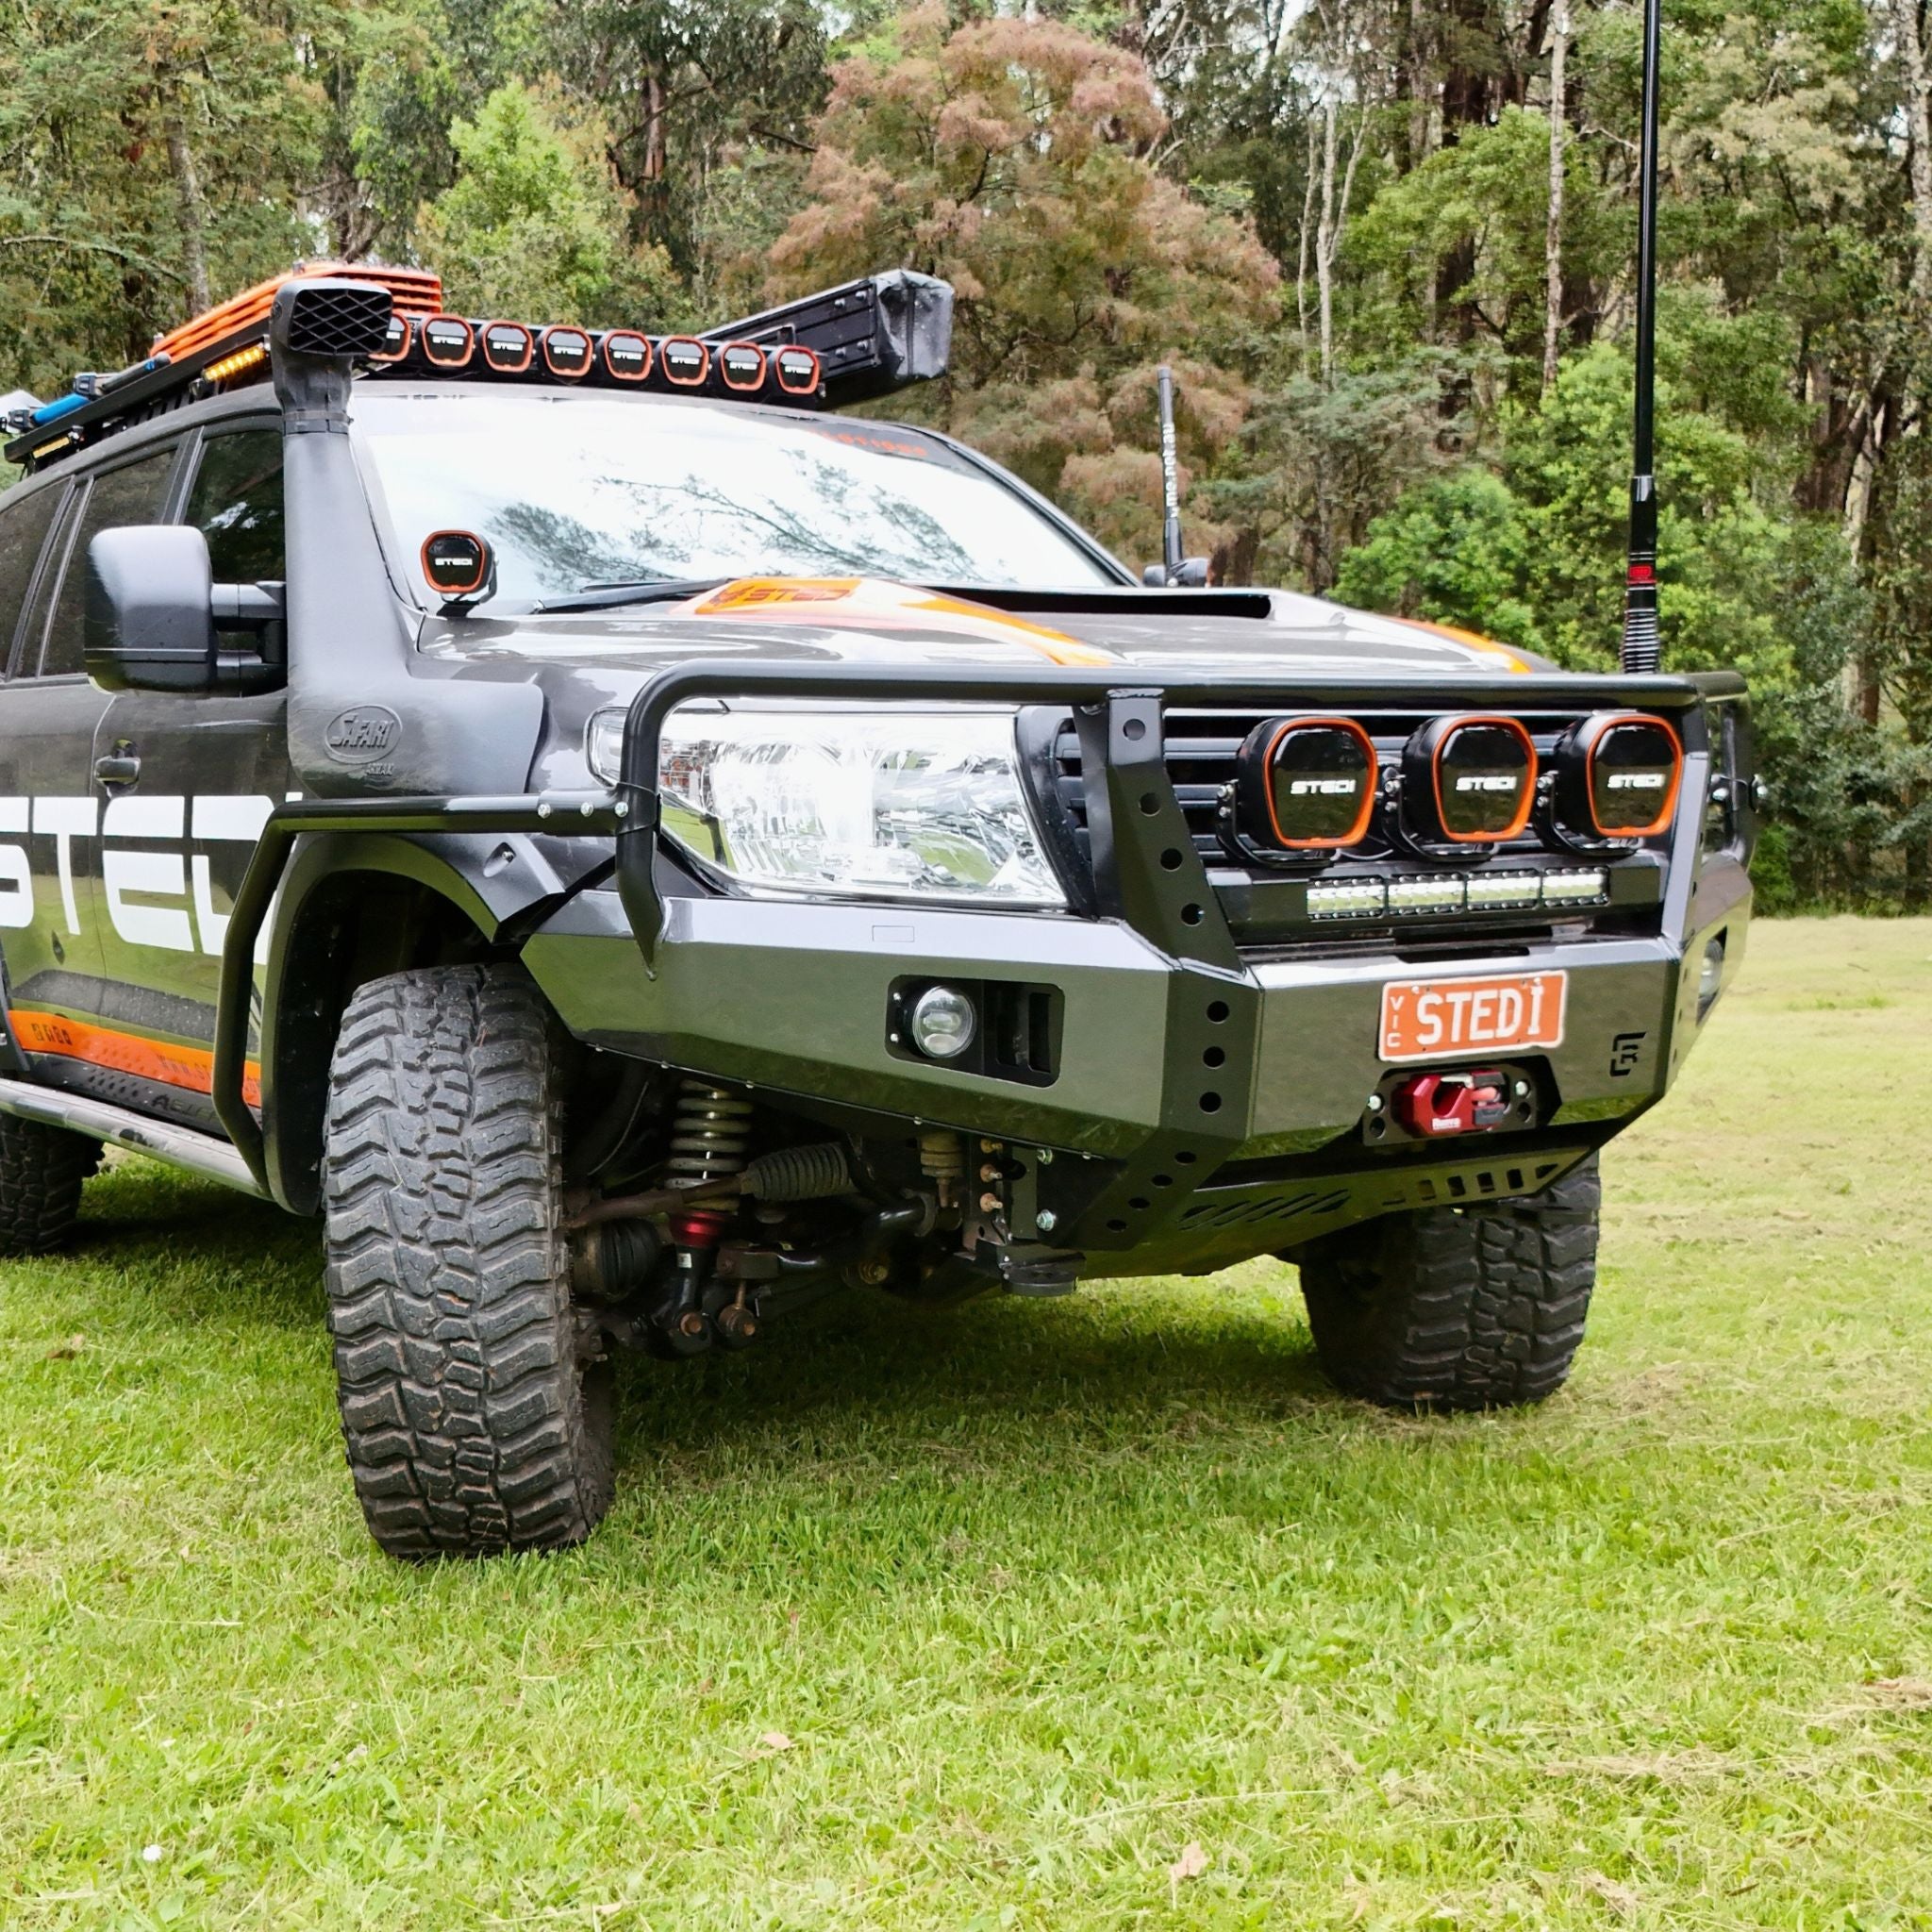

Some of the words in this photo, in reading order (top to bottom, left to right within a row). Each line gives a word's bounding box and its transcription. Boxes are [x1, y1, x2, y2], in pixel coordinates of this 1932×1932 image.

[435, 558, 473, 566] STEDI
[330, 713, 394, 748] SAFARI
[1291, 779, 1356, 794] STEDI
[1456, 776, 1517, 791] STEDI
[1607, 774, 1666, 789] STEDI
[1387, 995, 1404, 1047] VIC
[1416, 985, 1544, 1045] STEDI
